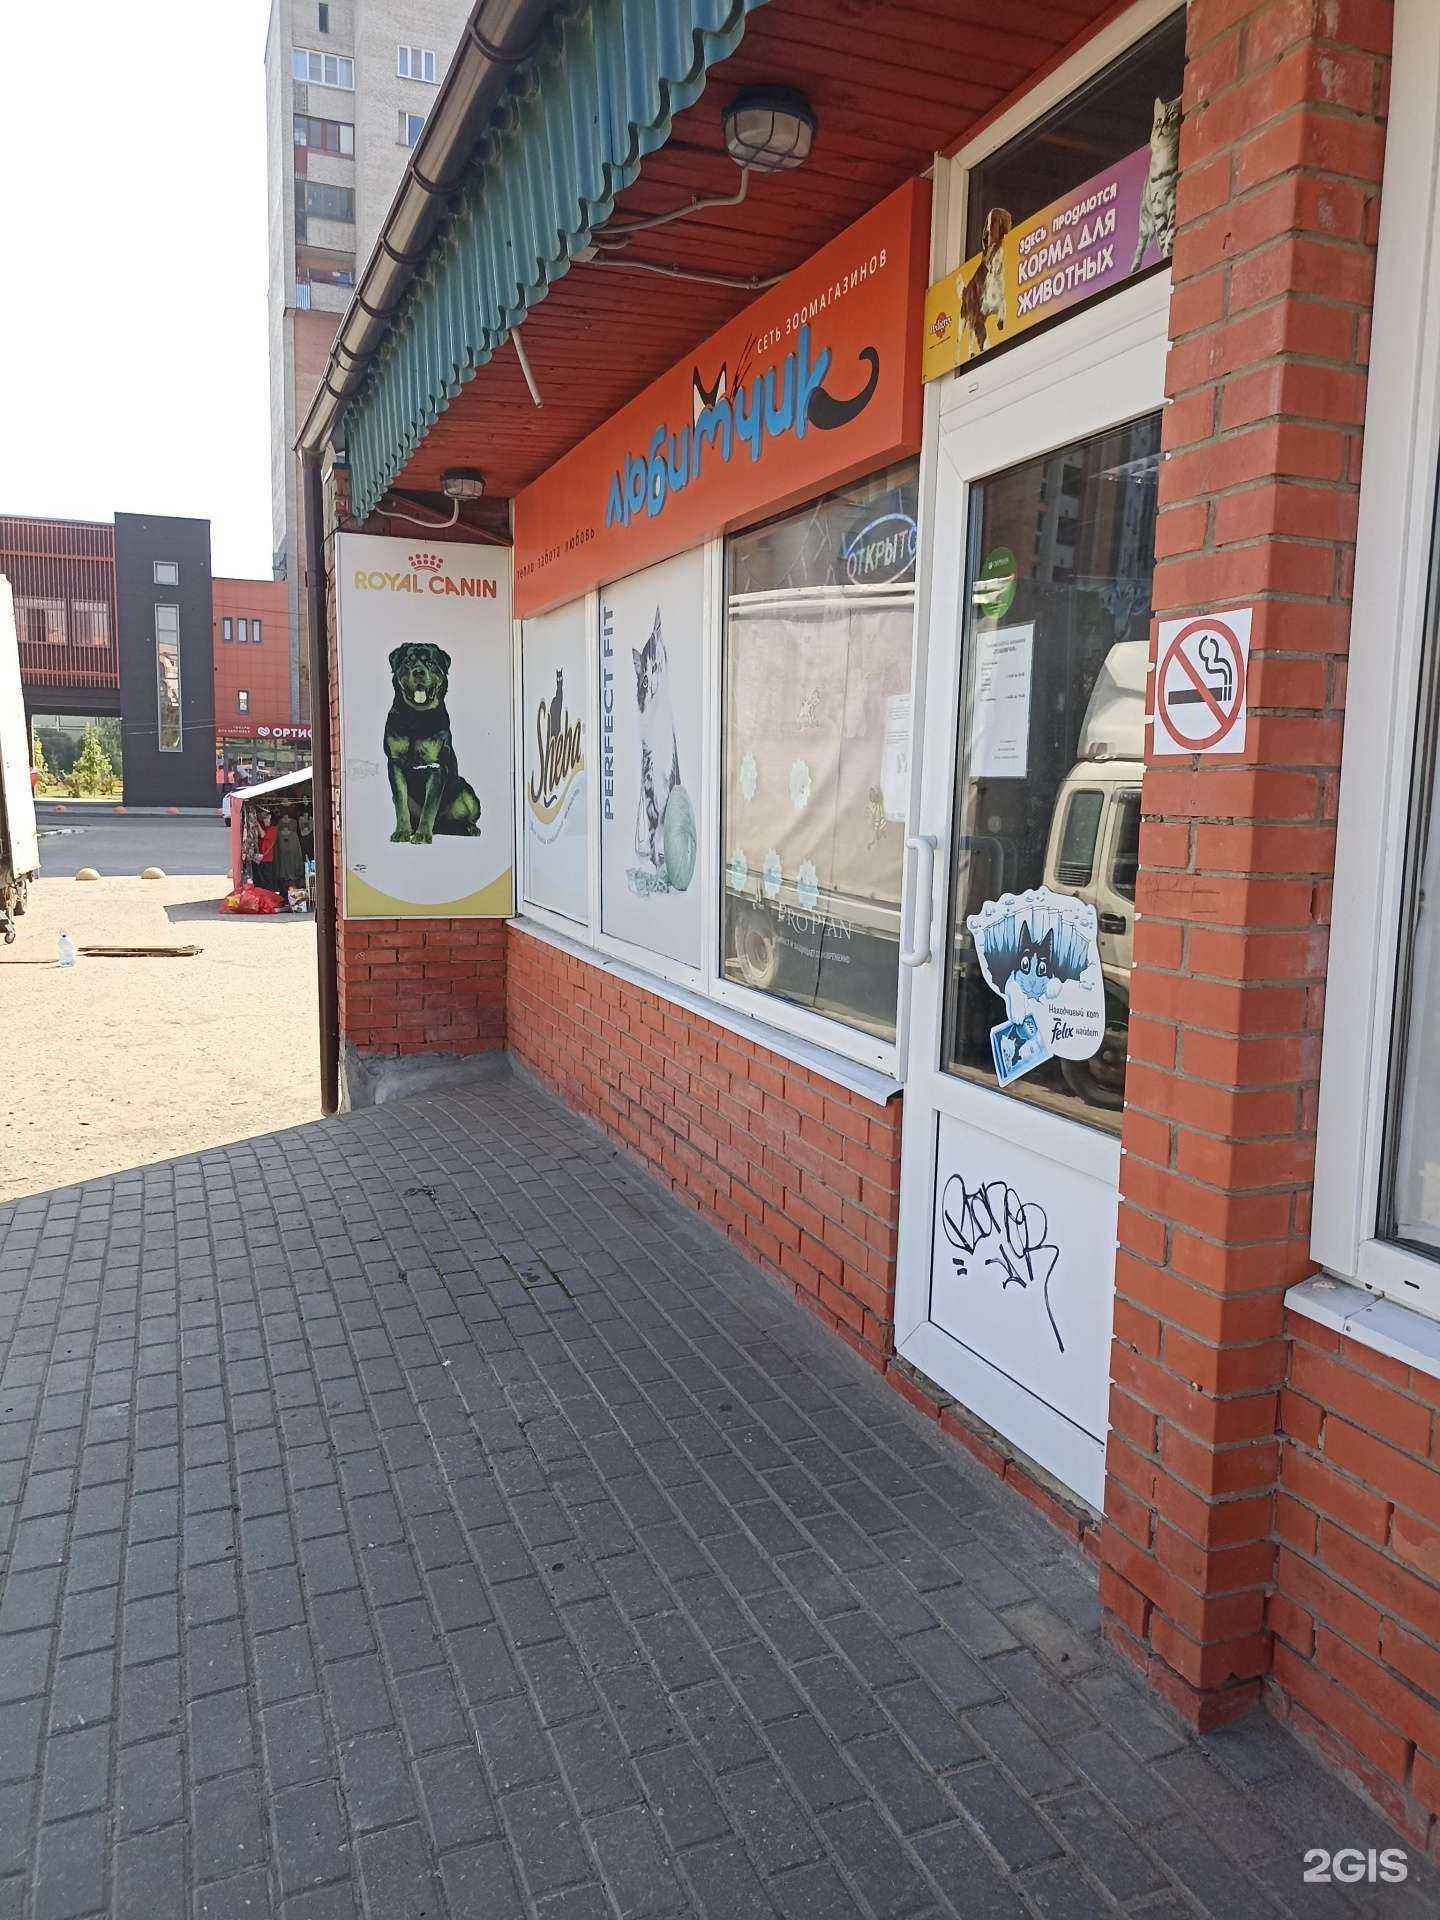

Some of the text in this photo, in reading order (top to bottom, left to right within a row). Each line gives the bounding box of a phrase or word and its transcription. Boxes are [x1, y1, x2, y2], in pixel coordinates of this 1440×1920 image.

[1017, 243, 1114, 317] ЖИВОТНЫХ
[1018, 208, 1116, 284] КОРМА ДЛЯ
[757, 248, 887, 354] СЕТЬ ЗООМАГАЗИНОВ
[564, 528, 596, 553] любовь
[847, 525, 917, 578] ОТКРЫТО
[354, 569, 497, 599] ROYAL CANIN
[603, 605, 615, 820] PERFECT FIT
[530, 699, 582, 803] Sheba
